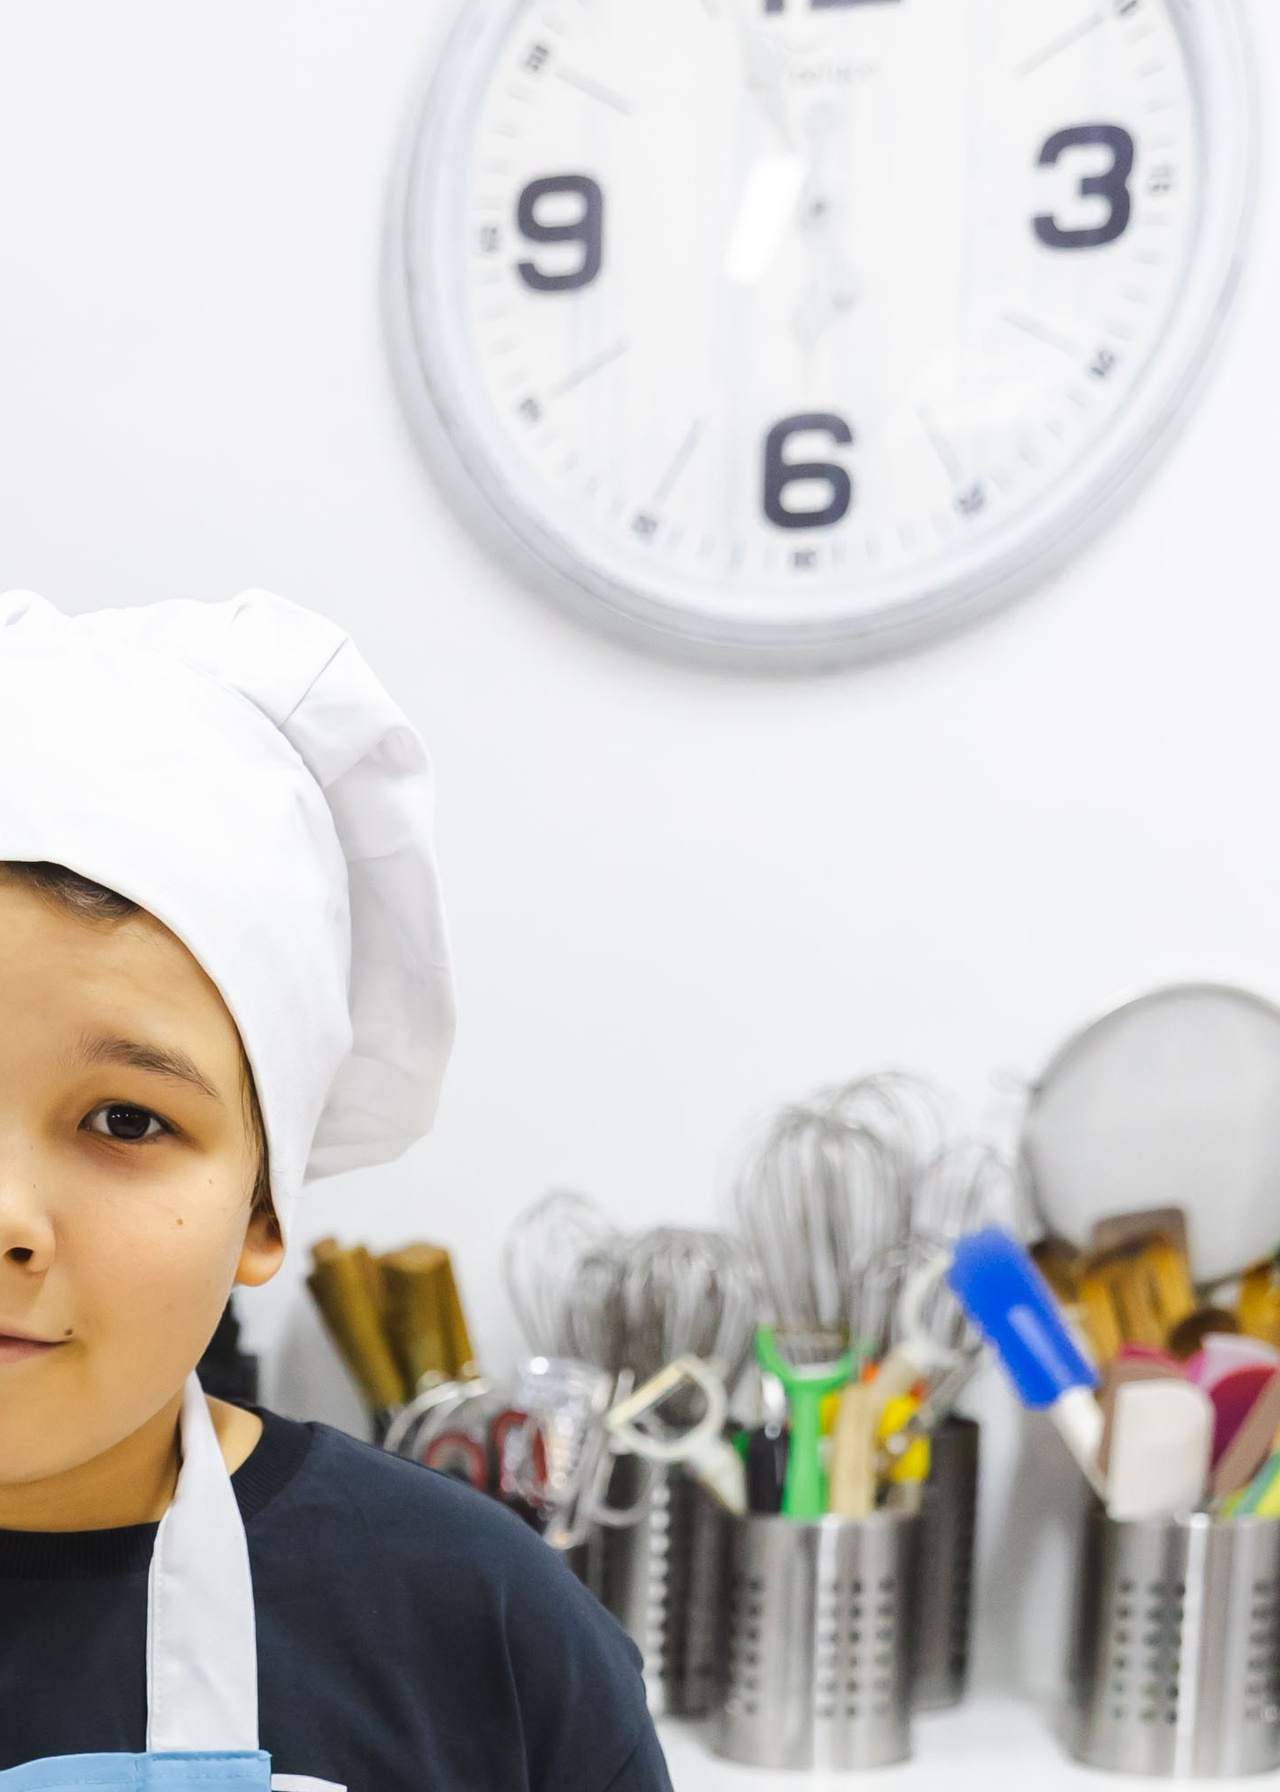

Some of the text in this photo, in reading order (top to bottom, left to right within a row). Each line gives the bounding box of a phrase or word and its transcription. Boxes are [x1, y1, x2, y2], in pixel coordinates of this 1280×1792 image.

[518, 174, 604, 292] 9
[1032, 125, 1135, 250] 3
[762, 413, 853, 530] 6
